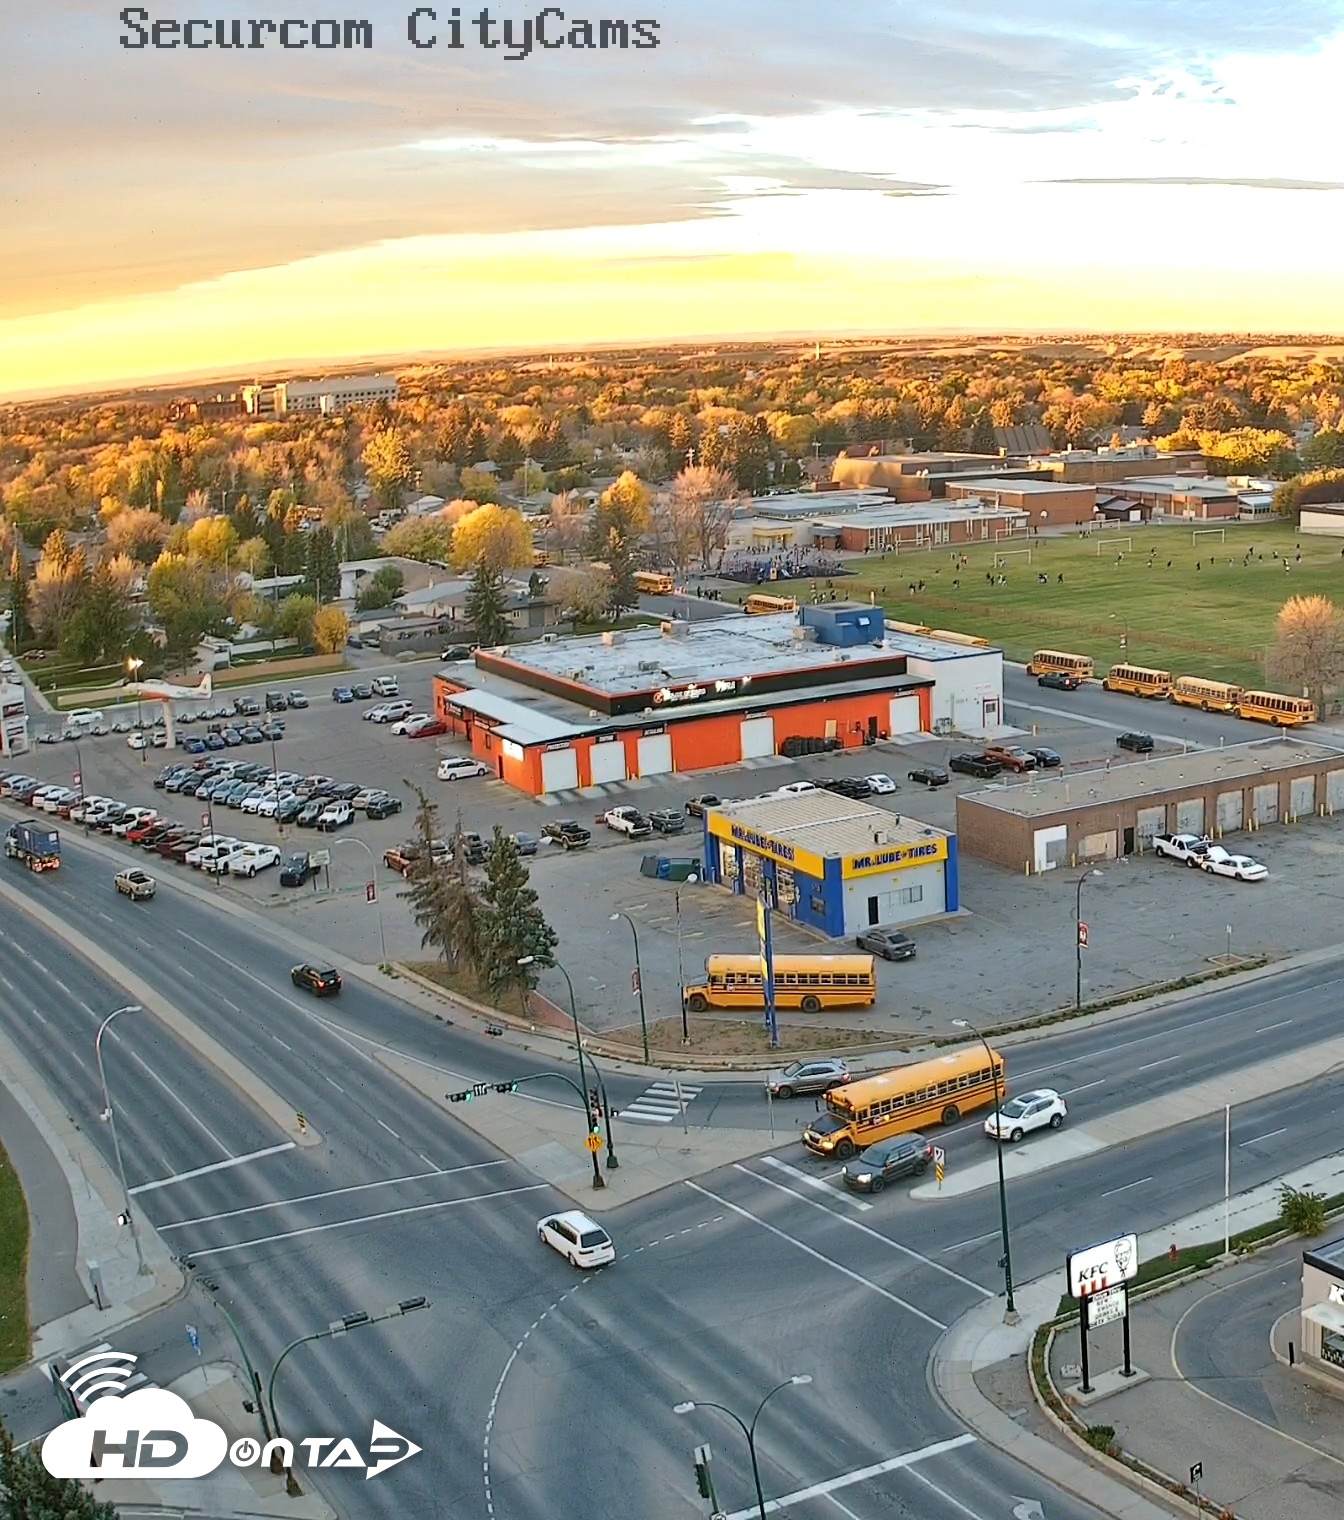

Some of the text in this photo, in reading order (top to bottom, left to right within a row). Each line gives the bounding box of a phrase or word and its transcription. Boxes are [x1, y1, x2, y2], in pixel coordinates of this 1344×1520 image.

[770, 839, 794, 861] TIRES
[853, 856, 875, 869] MR.
[875, 850, 901, 865] LUBE
[908, 843, 937, 858] TIRES
[1078, 1261, 1108, 1283] KFC
